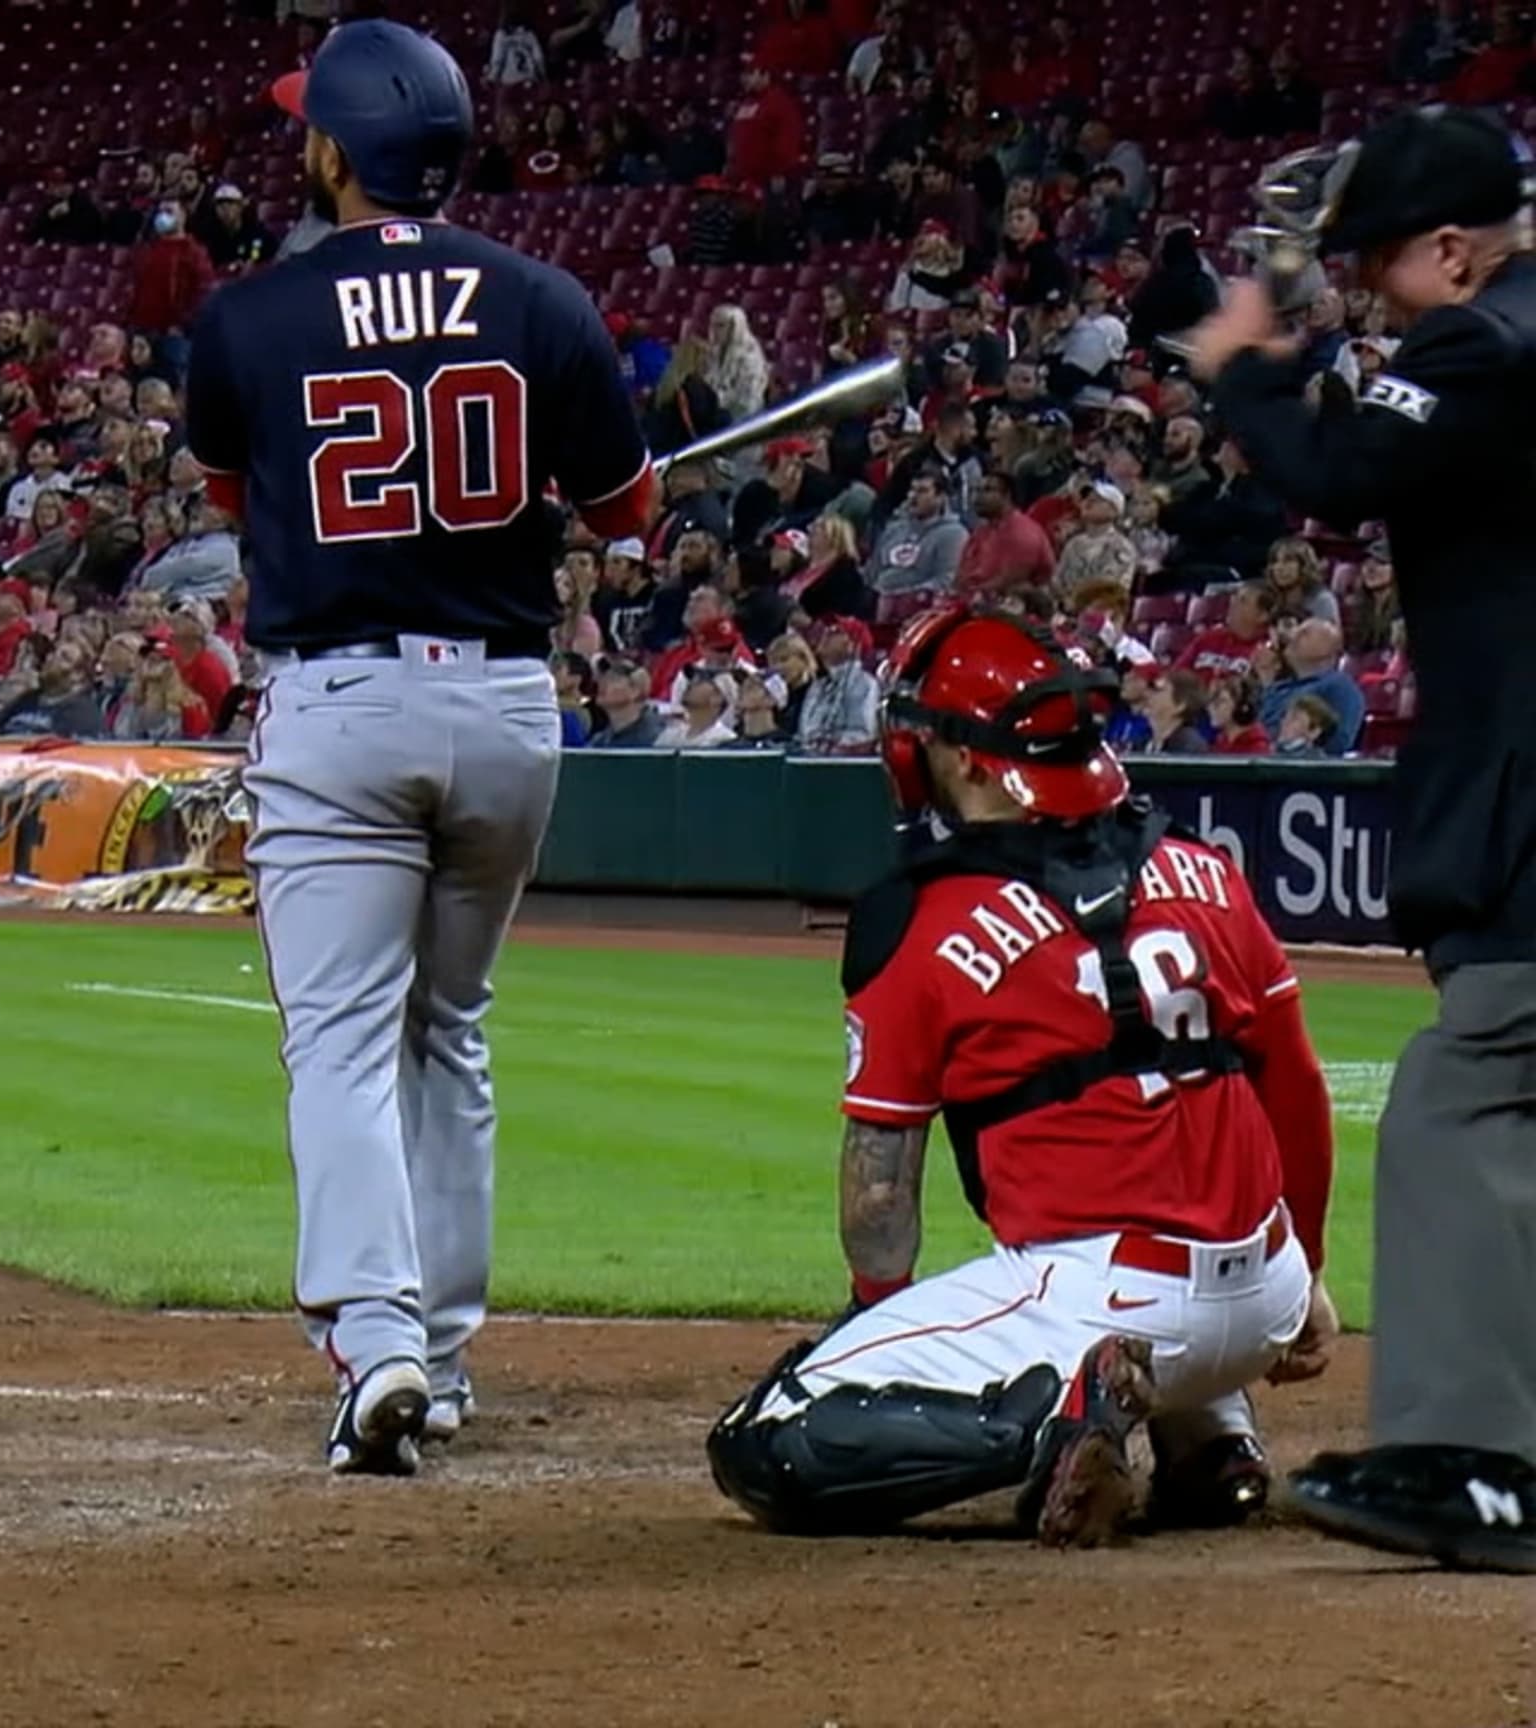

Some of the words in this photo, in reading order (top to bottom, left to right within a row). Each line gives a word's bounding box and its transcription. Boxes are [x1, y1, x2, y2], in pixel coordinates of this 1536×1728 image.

[335, 268, 481, 348] RUIZ
[302, 360, 528, 544] 20
[936, 845, 1230, 995] BARART
